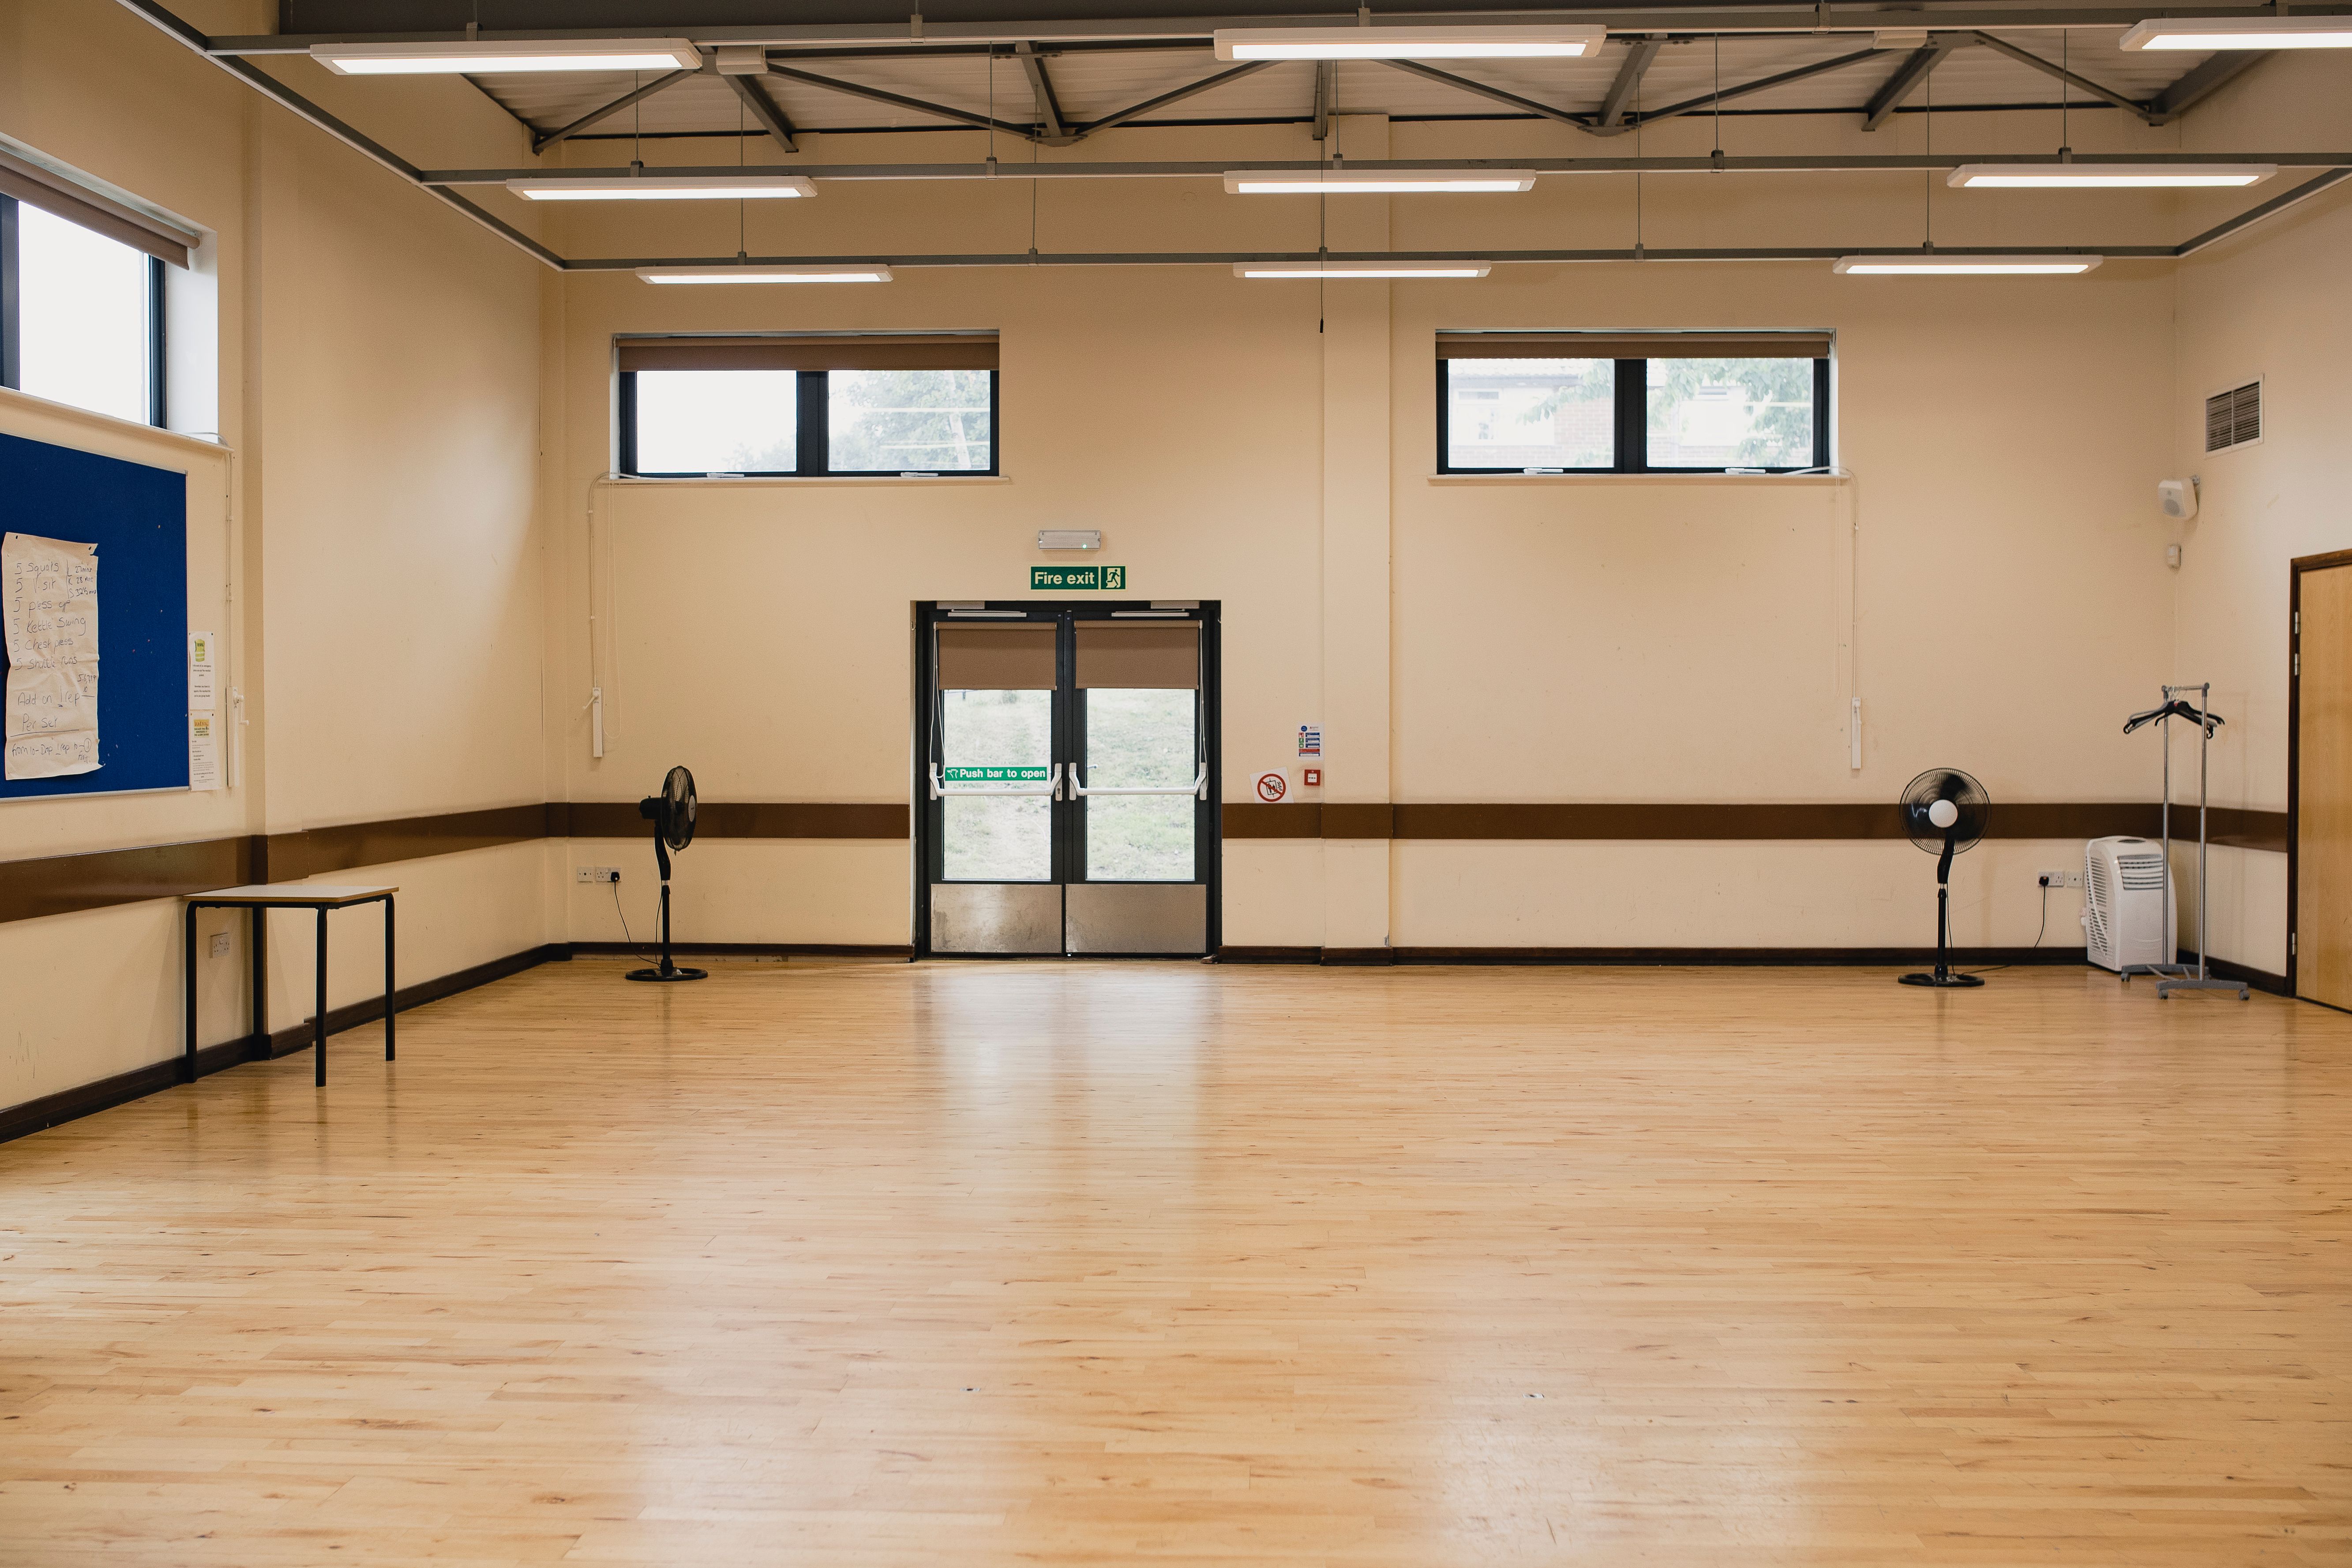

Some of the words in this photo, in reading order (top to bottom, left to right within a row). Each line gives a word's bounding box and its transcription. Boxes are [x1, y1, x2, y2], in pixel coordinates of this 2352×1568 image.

[15, 563, 22, 574] 5
[26, 562, 59, 577] Squats
[15, 578, 23, 593] 5
[1035, 572, 1062, 585] Fire
[1067, 572, 1095, 585] exit
[13, 597, 23, 612] 5
[13, 618, 20, 634] 5
[27, 619, 53, 634] Kettle
[57, 617, 86, 636] Swing
[14, 639, 20, 652] 5
[25, 638, 51, 650] Chest
[15, 658, 23, 671] 5
[18, 692, 36, 706] Add
[42, 695, 52, 705] on
[65, 691, 80, 706] rep
[23, 713, 36, 731] Per
[41, 716, 57, 728] Set
[41, 744, 53, 755] Drop
[960, 769, 983, 778] Push
[987, 769, 1003, 778] bar
[1007, 769, 1017, 778] to
[1021, 769, 1046, 780] open
